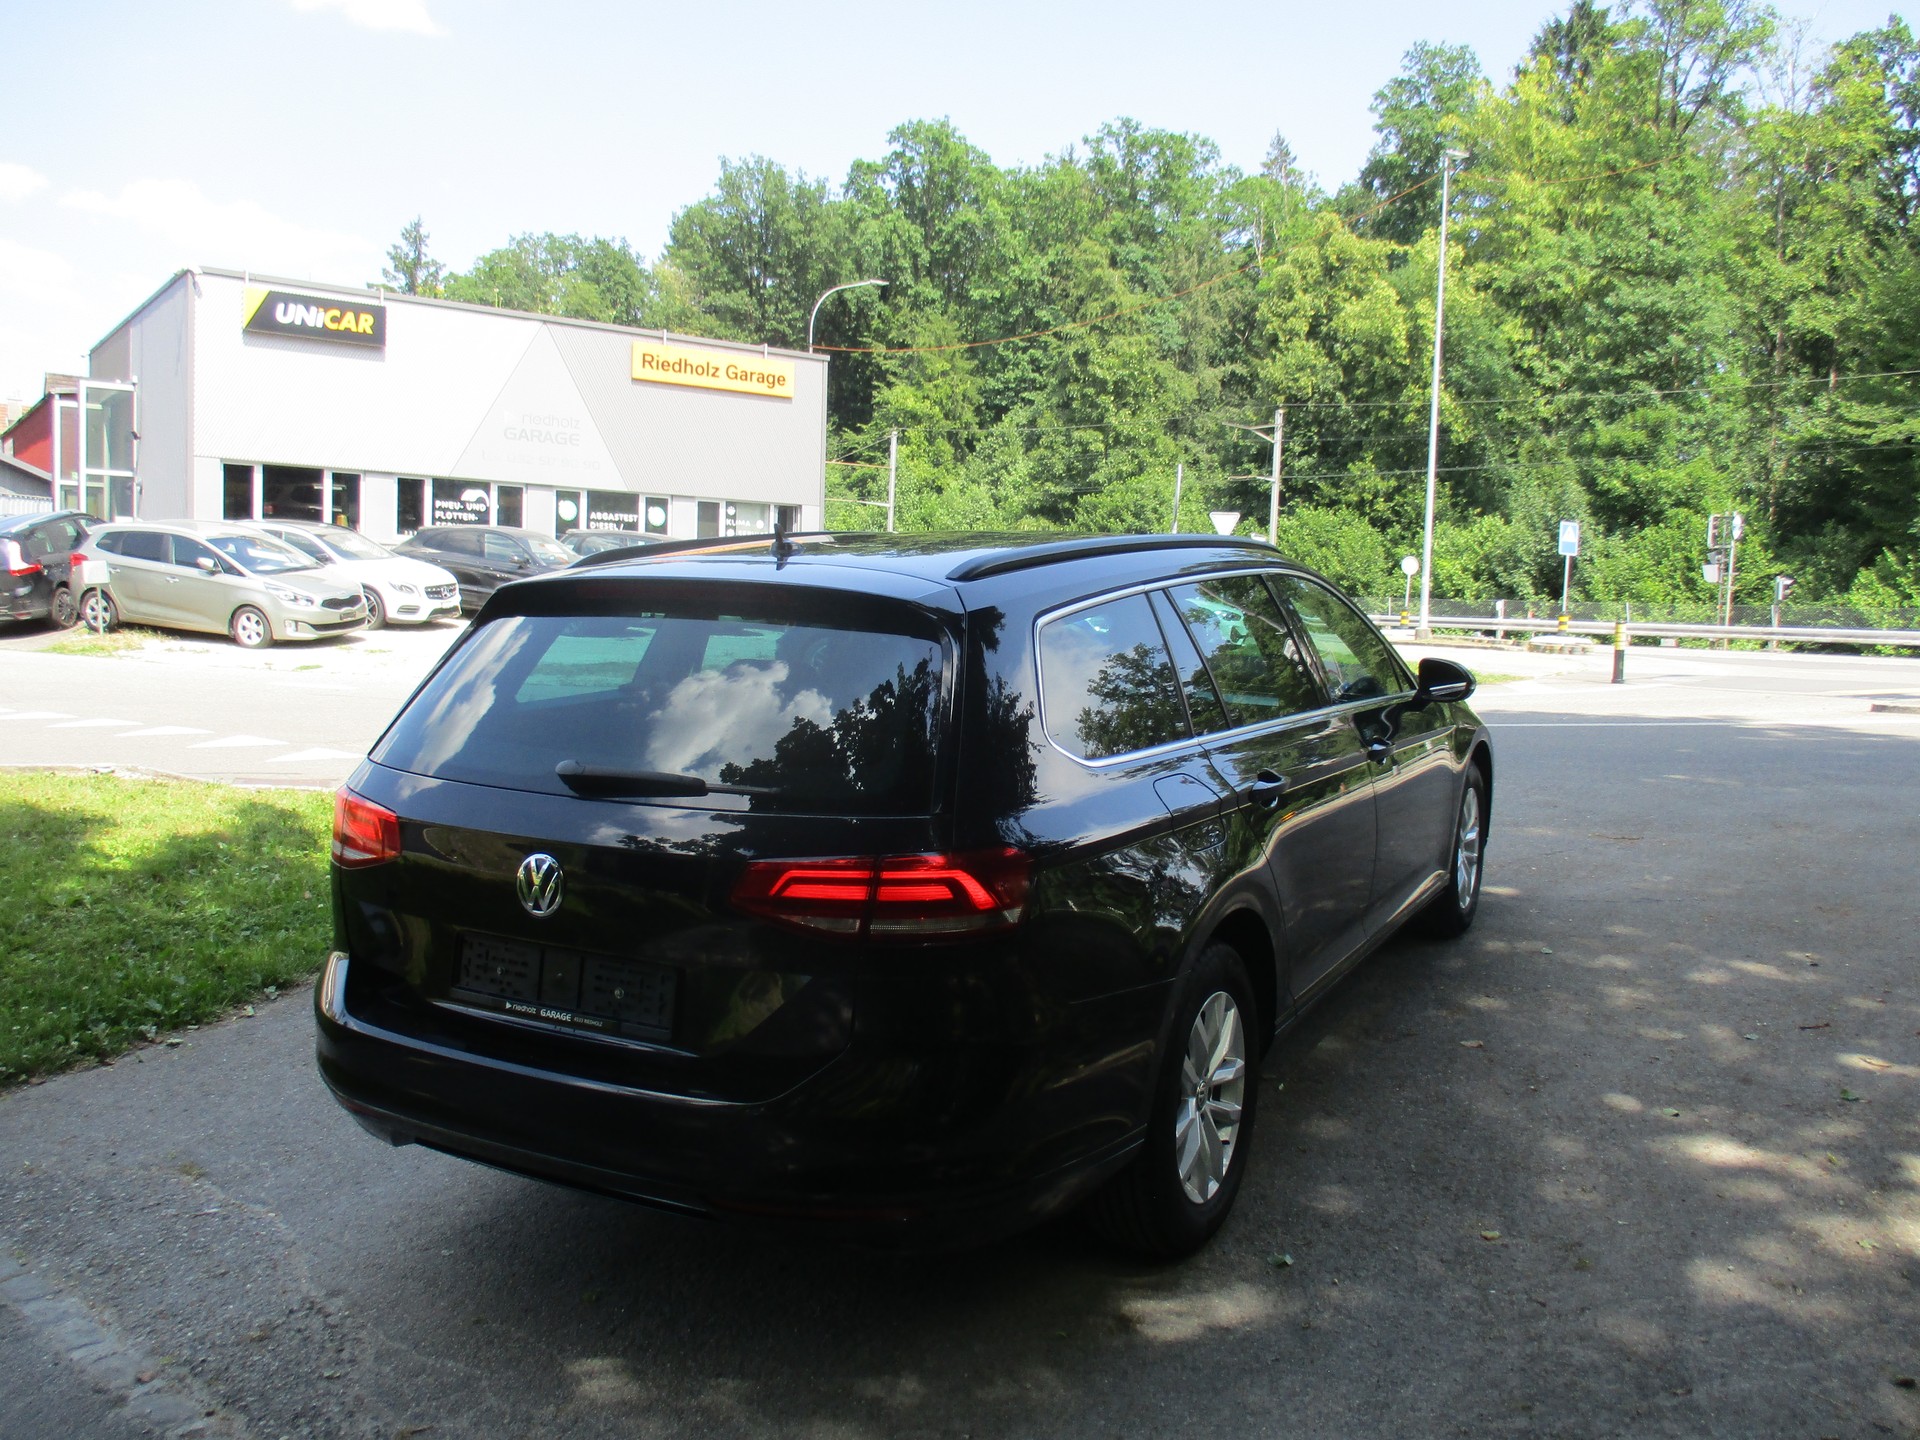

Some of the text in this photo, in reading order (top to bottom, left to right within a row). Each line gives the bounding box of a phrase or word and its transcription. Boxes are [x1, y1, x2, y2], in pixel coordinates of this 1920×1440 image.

[642, 353, 786, 389] Riedholz Garage
[504, 427, 580, 446] GARAGE
[466, 502, 486, 512] UND
[590, 511, 638, 522] ABGASTEST
[540, 1008, 571, 1021] GARAGE
